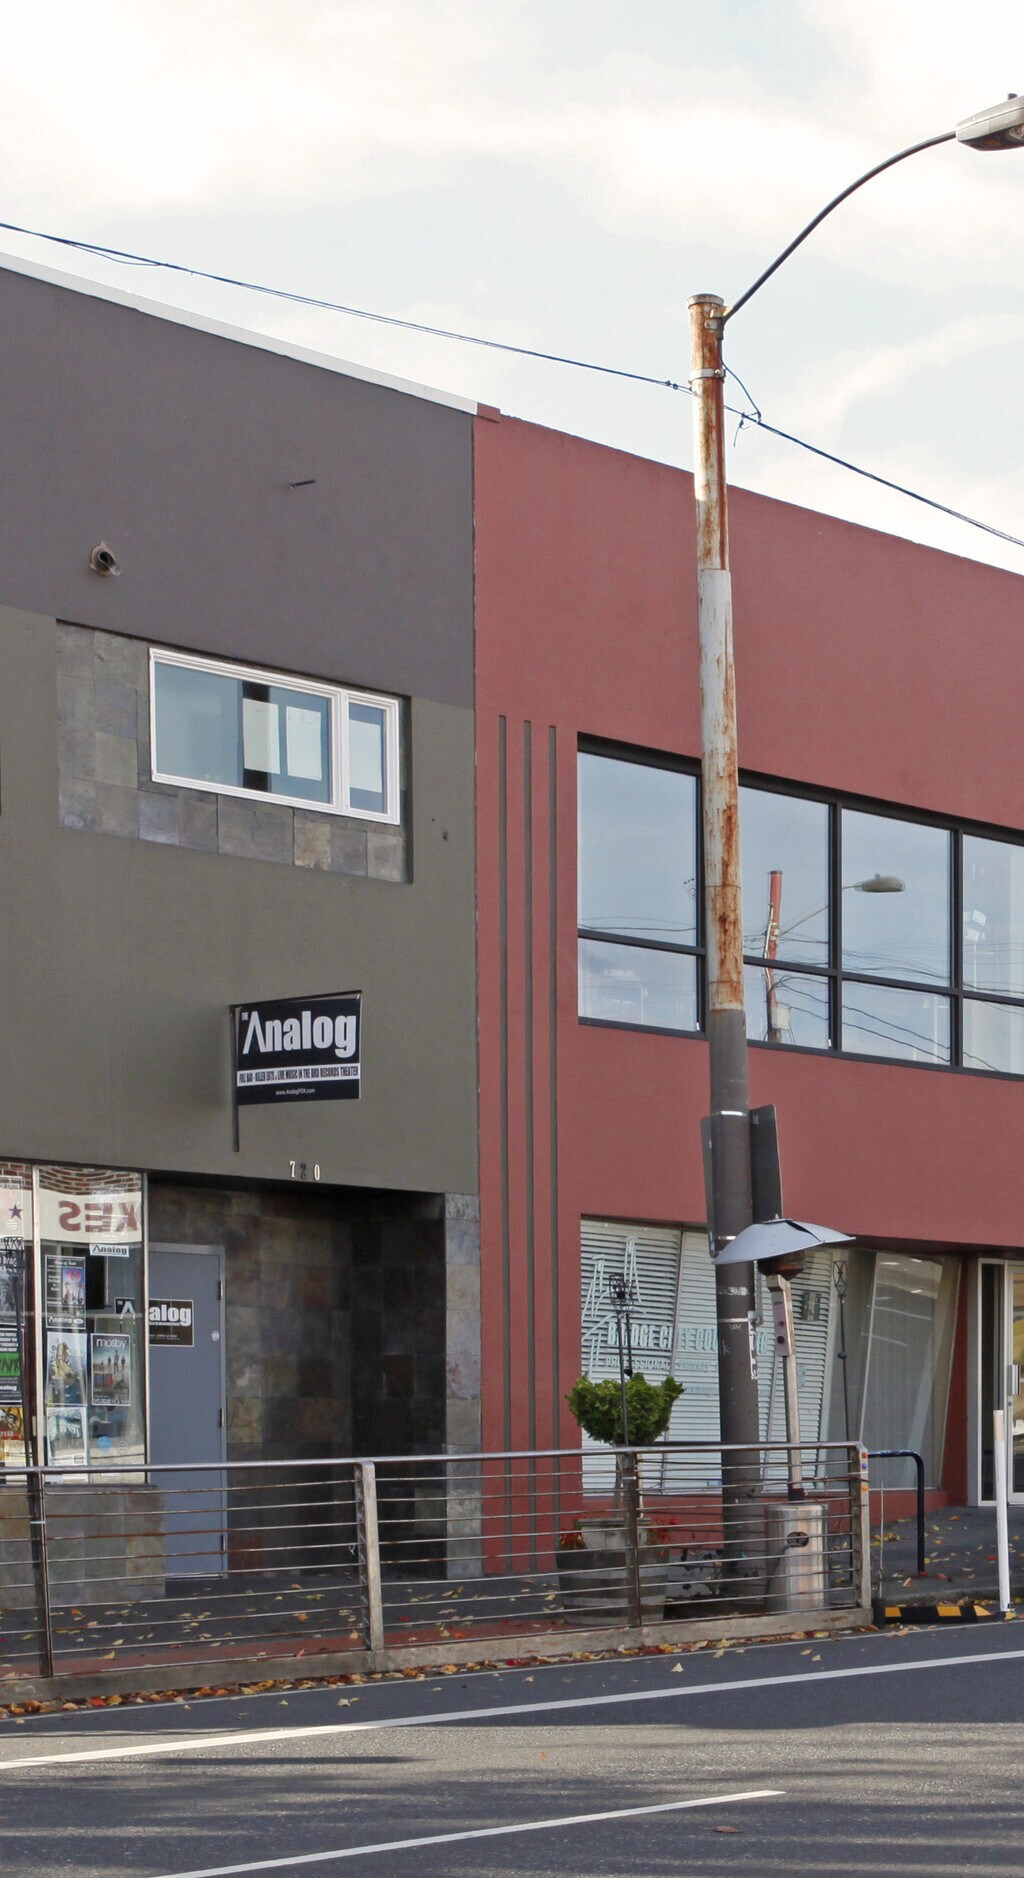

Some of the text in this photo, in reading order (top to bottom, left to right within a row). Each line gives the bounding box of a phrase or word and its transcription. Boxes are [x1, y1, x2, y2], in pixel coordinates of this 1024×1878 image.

[242, 1010, 357, 1058] Analog
[285, 1069, 297, 1079] MUSIC
[320, 1066, 339, 1077] RECORDS
[340, 1066, 358, 1076] THEATER
